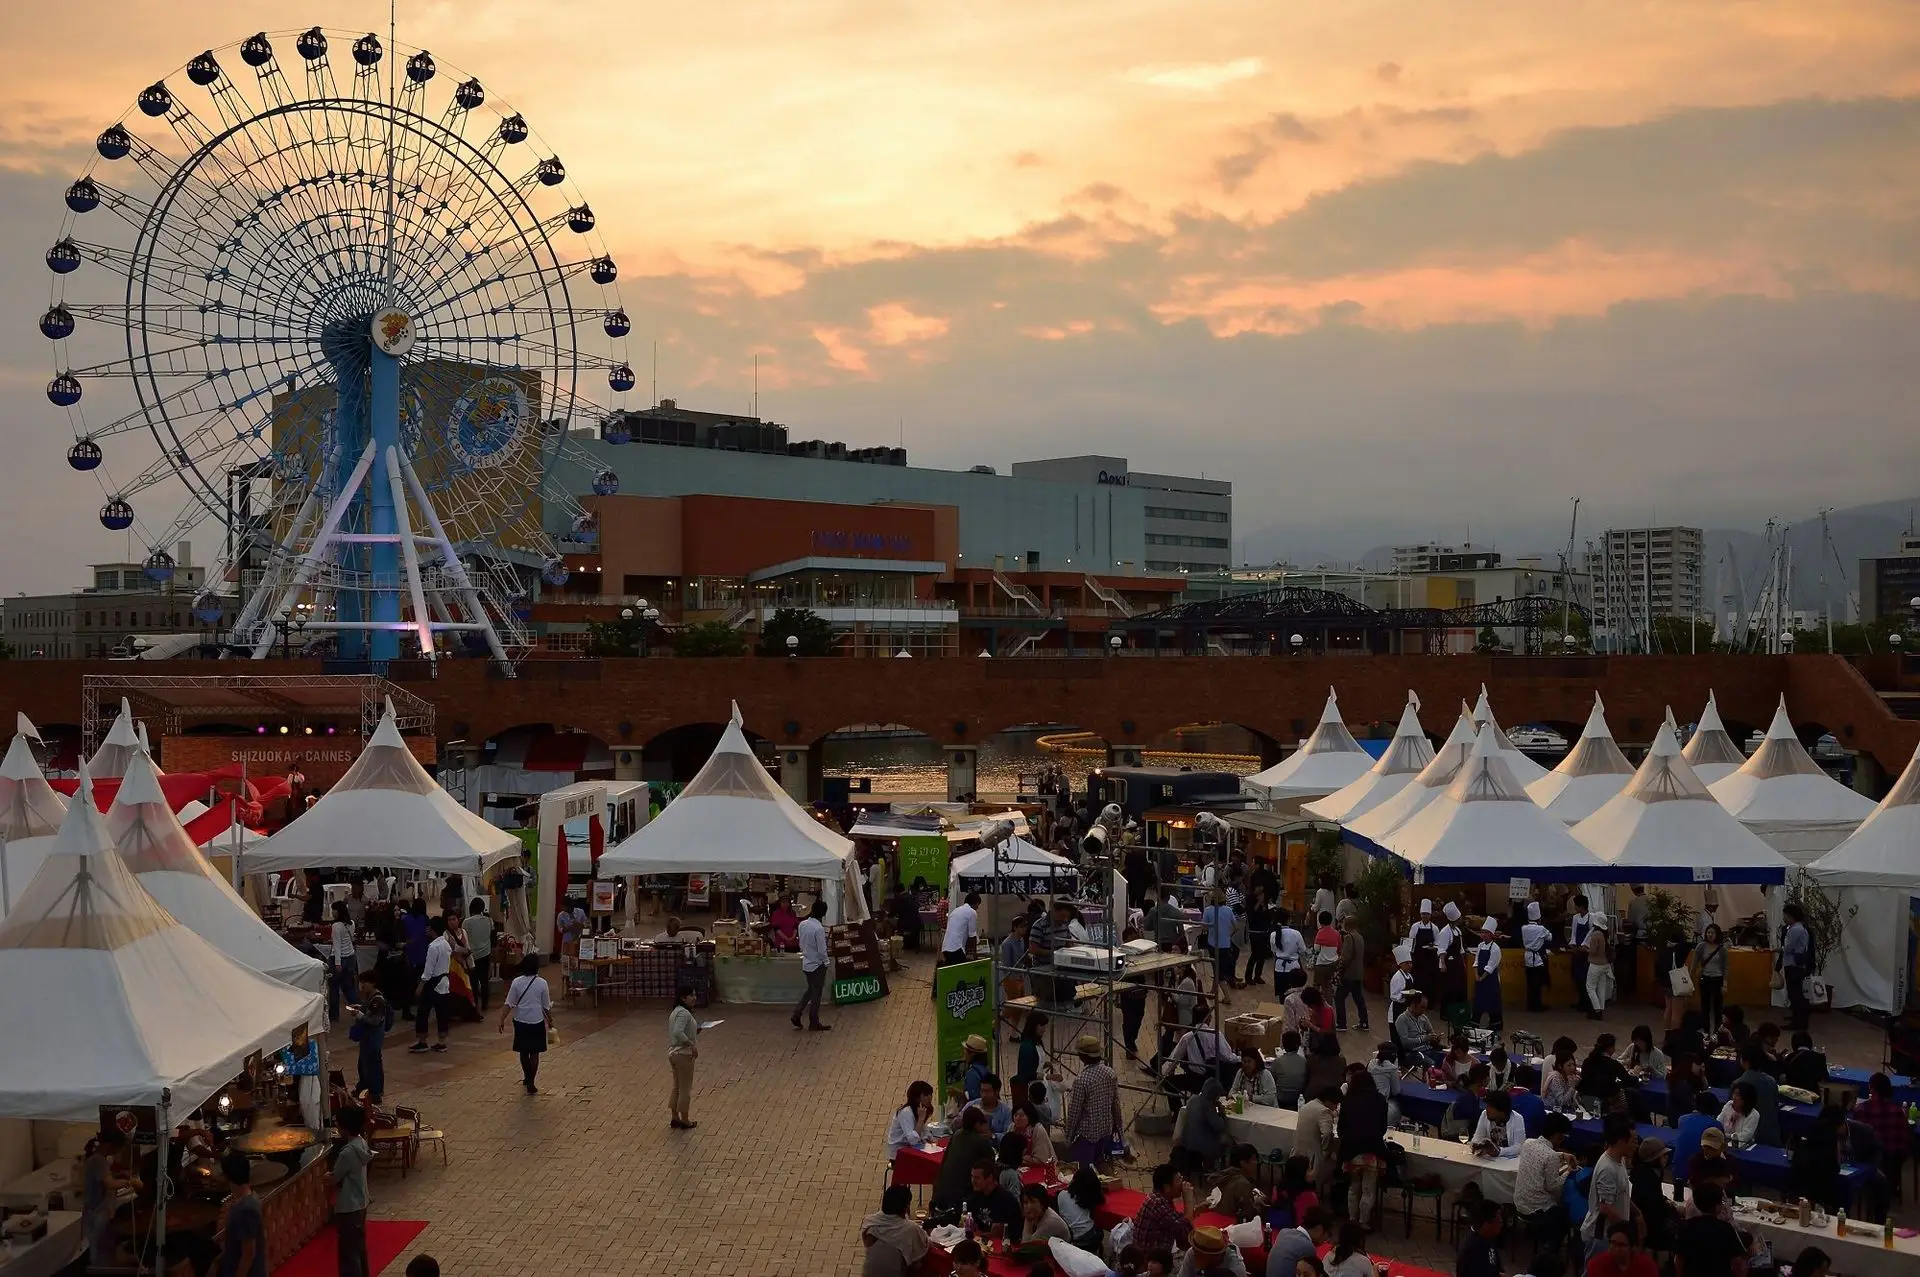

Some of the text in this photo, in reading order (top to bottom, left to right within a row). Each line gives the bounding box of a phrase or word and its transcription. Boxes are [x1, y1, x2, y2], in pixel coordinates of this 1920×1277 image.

[231, 750, 352, 762] SHIZUOKA CANNES
[907, 846, 940, 857] 海辺の
